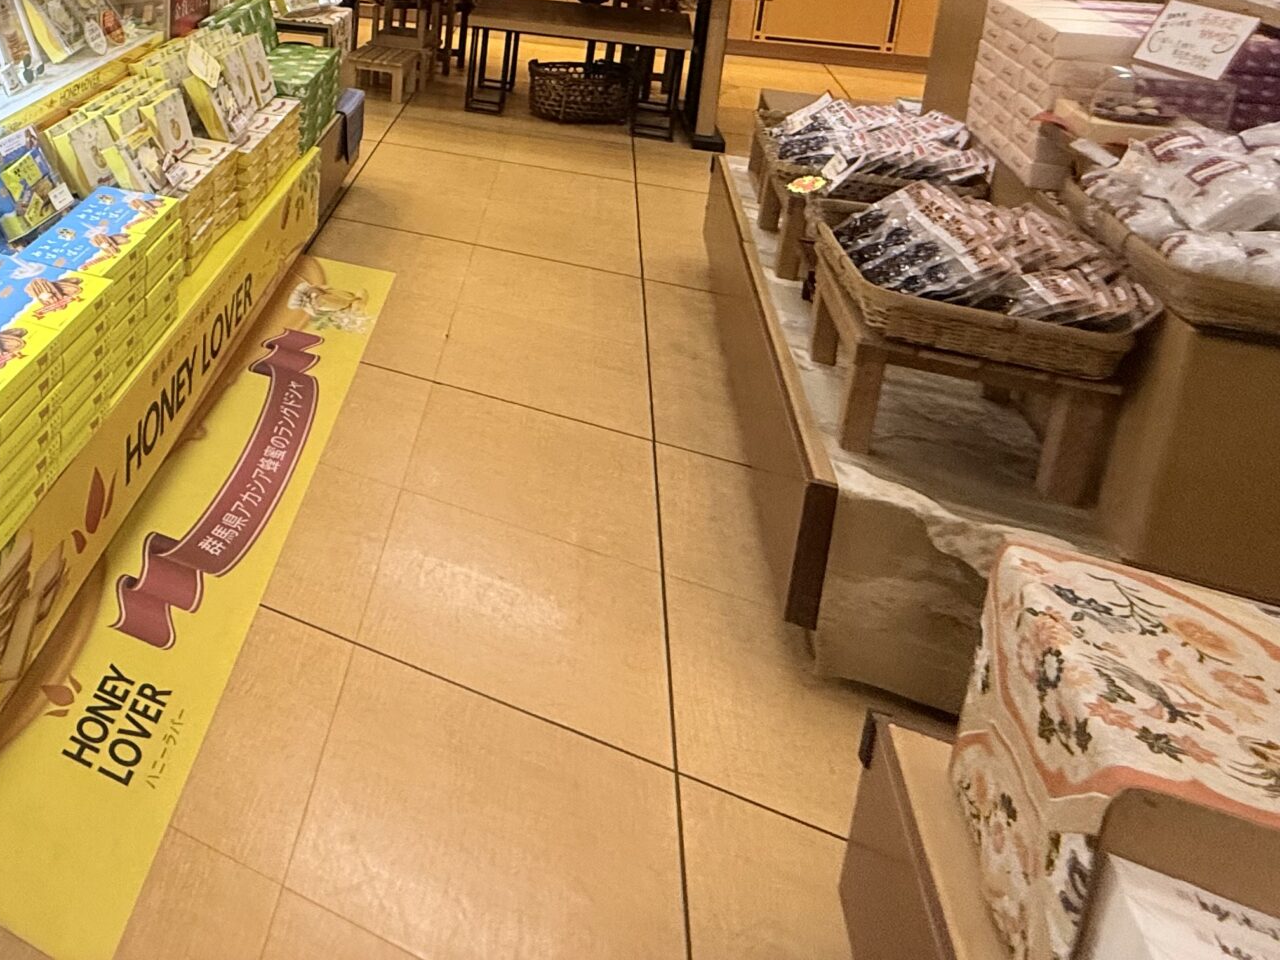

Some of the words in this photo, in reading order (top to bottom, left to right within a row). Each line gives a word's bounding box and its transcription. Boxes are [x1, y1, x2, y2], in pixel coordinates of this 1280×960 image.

[125, 346, 197, 486] HONEY
[201, 272, 253, 377] LOVER
[198, 380, 305, 557] 群馬県アカシア蜂蜜のラングドシャ
[62, 663, 135, 768] HONEY
[97, 683, 173, 787] LOVER
[145, 708, 184, 789] ハニーラバー
